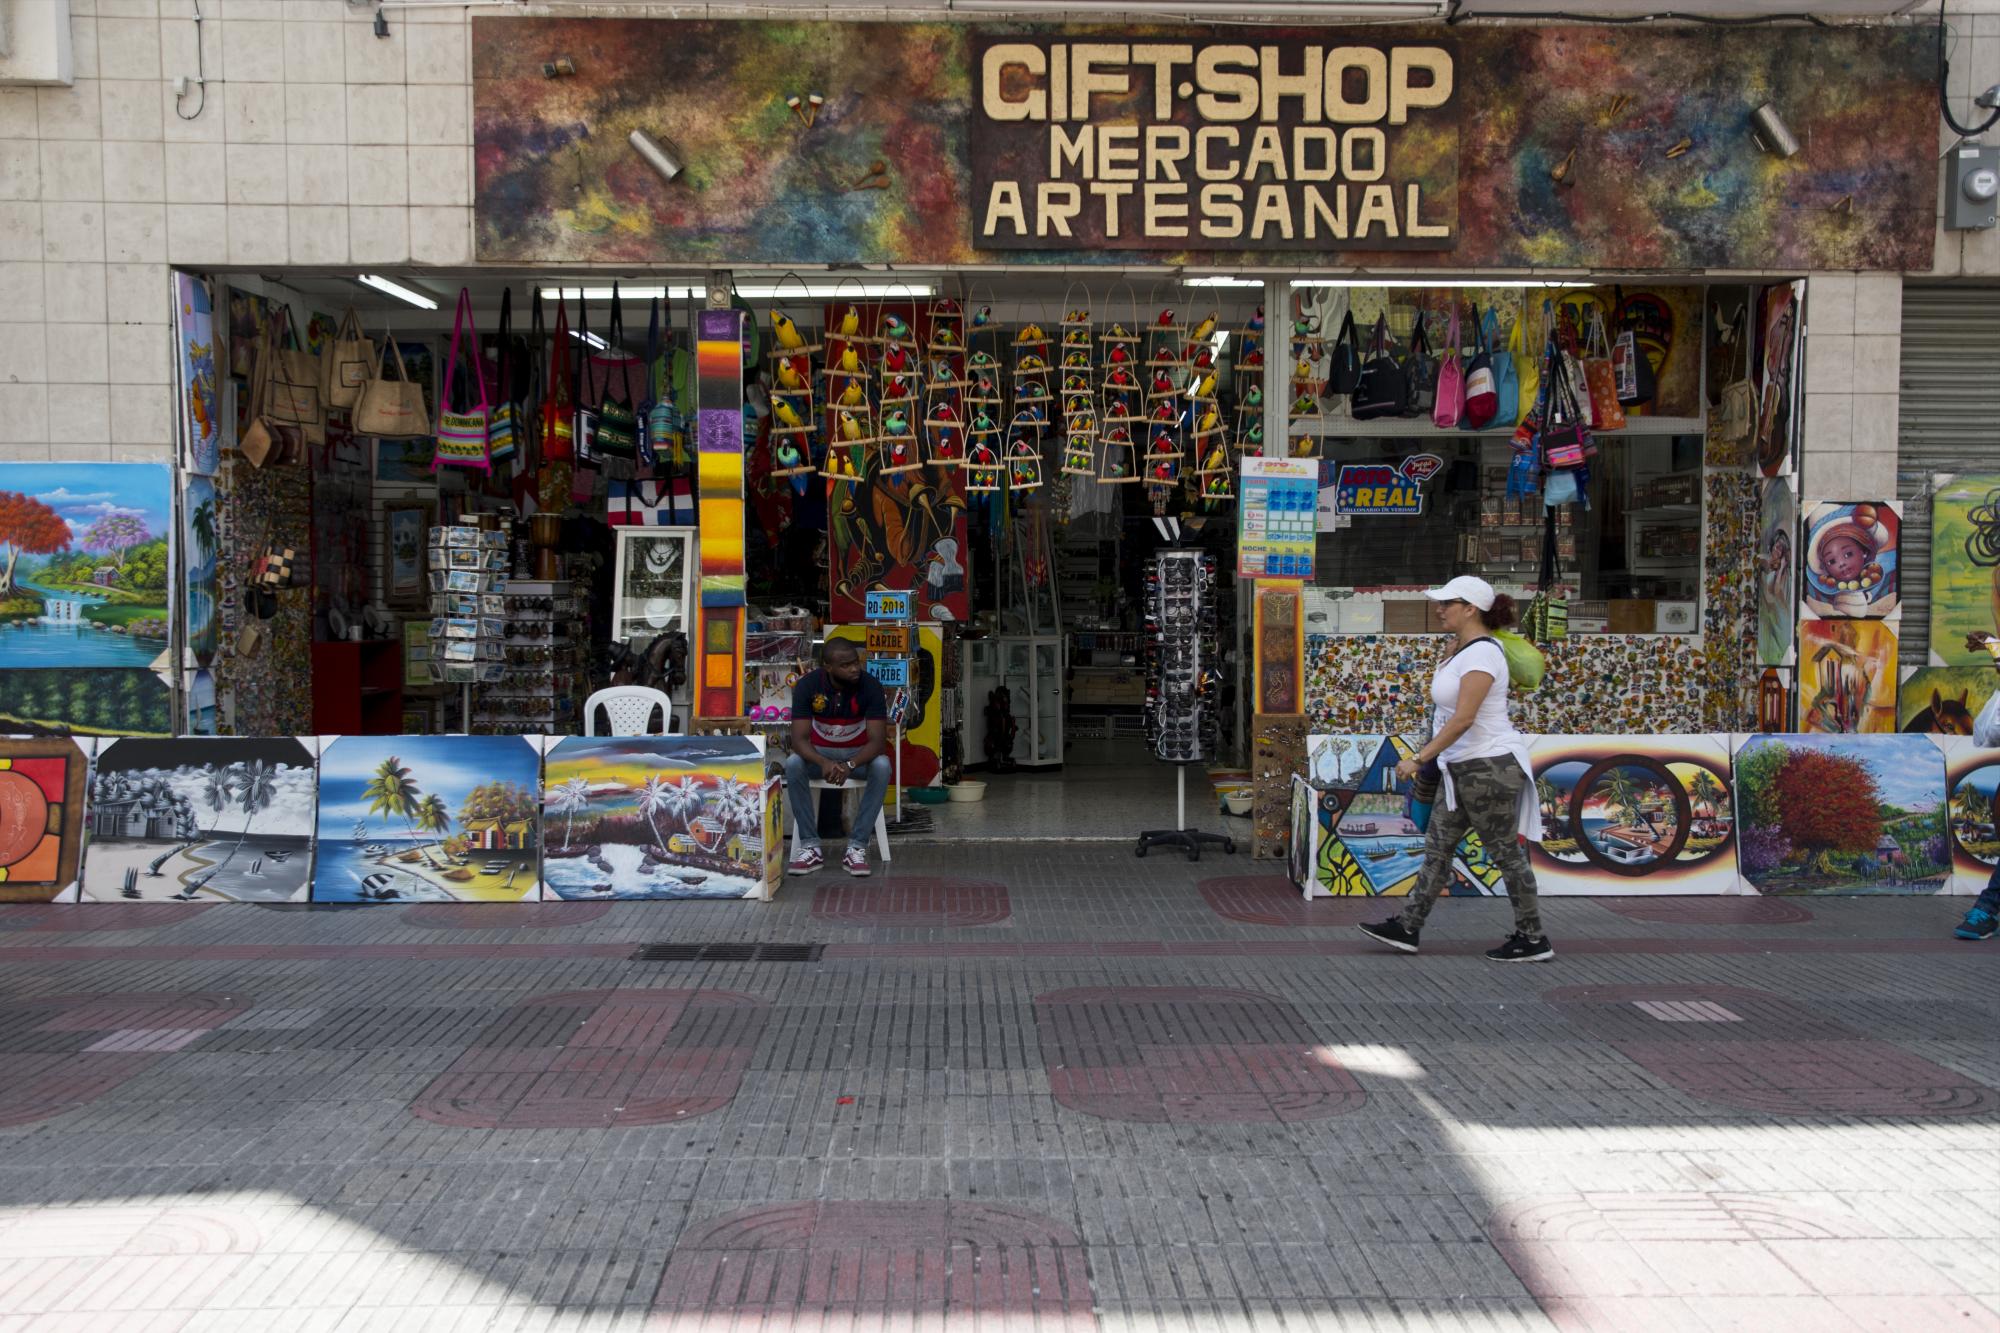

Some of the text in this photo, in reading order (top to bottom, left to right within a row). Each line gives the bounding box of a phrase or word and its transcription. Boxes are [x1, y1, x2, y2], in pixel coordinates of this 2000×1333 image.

[1050, 124, 1386, 182] MERCADO
[983, 181, 1450, 239] ARTESANAL
[1343, 469, 1392, 485] LOTO
[1355, 487, 1417, 507] REAL
[867, 601, 905, 614] RD-2018
[870, 634, 903, 648] CARIBE
